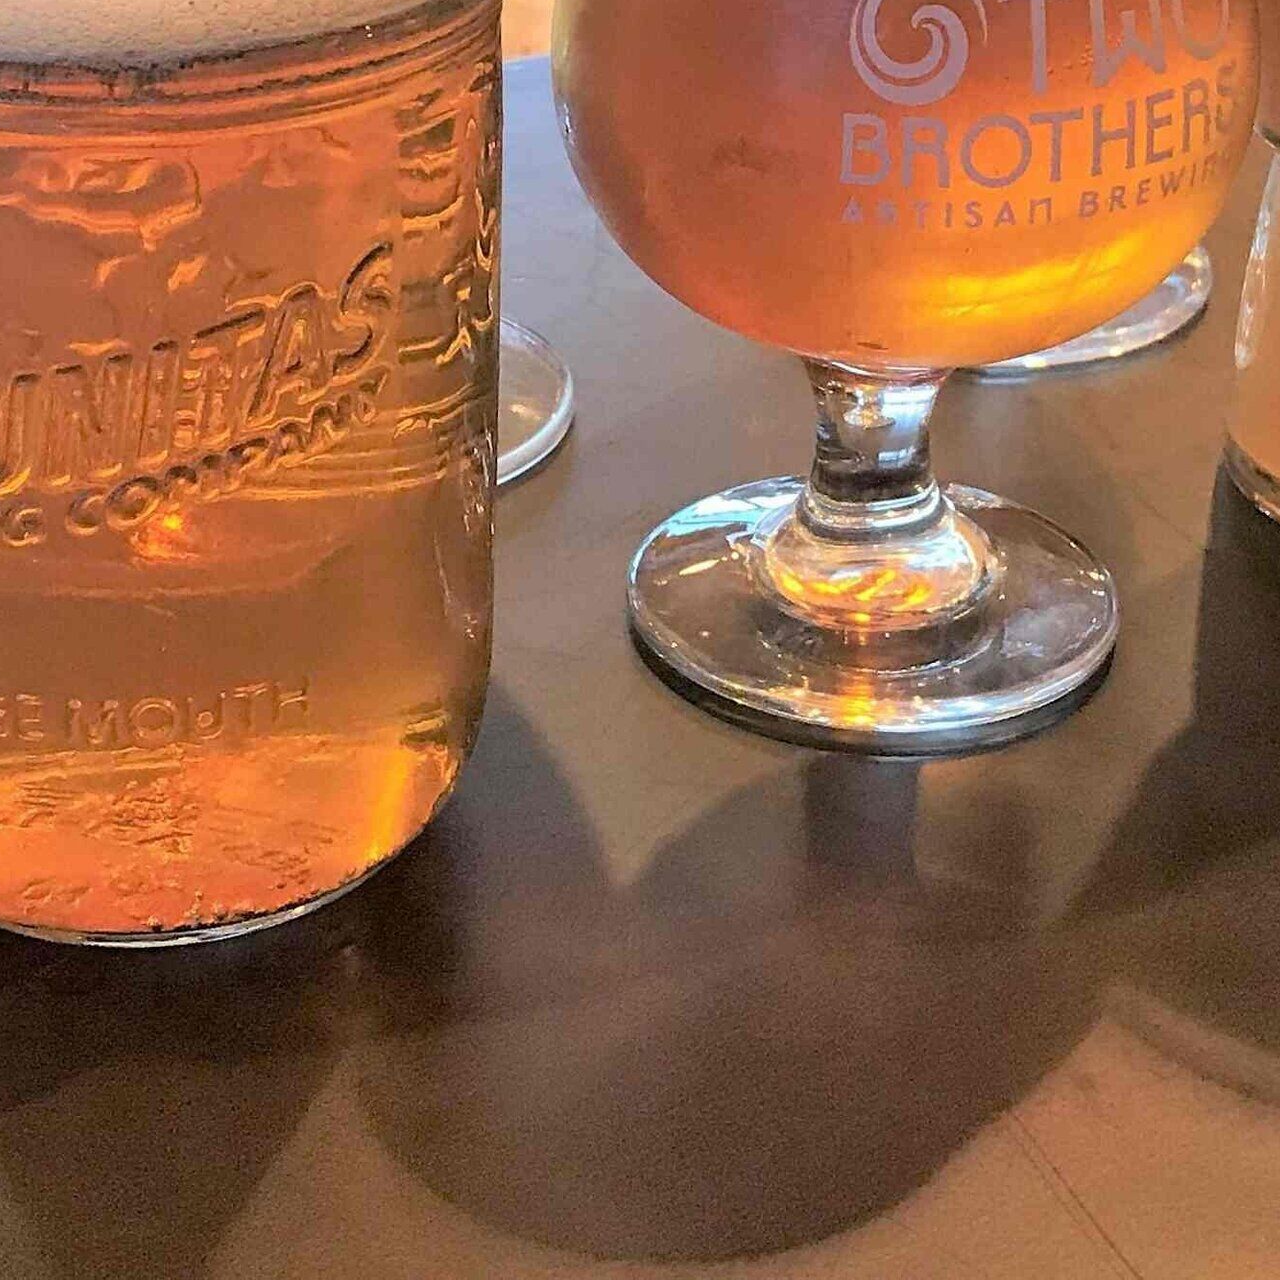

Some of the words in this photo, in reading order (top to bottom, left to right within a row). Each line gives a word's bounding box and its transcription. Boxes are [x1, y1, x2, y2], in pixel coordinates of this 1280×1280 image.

[839, 60, 1236, 189] BROTHERS
[1079, 149, 1232, 217] BREWIN
[64, 674, 310, 749] MOUTH
